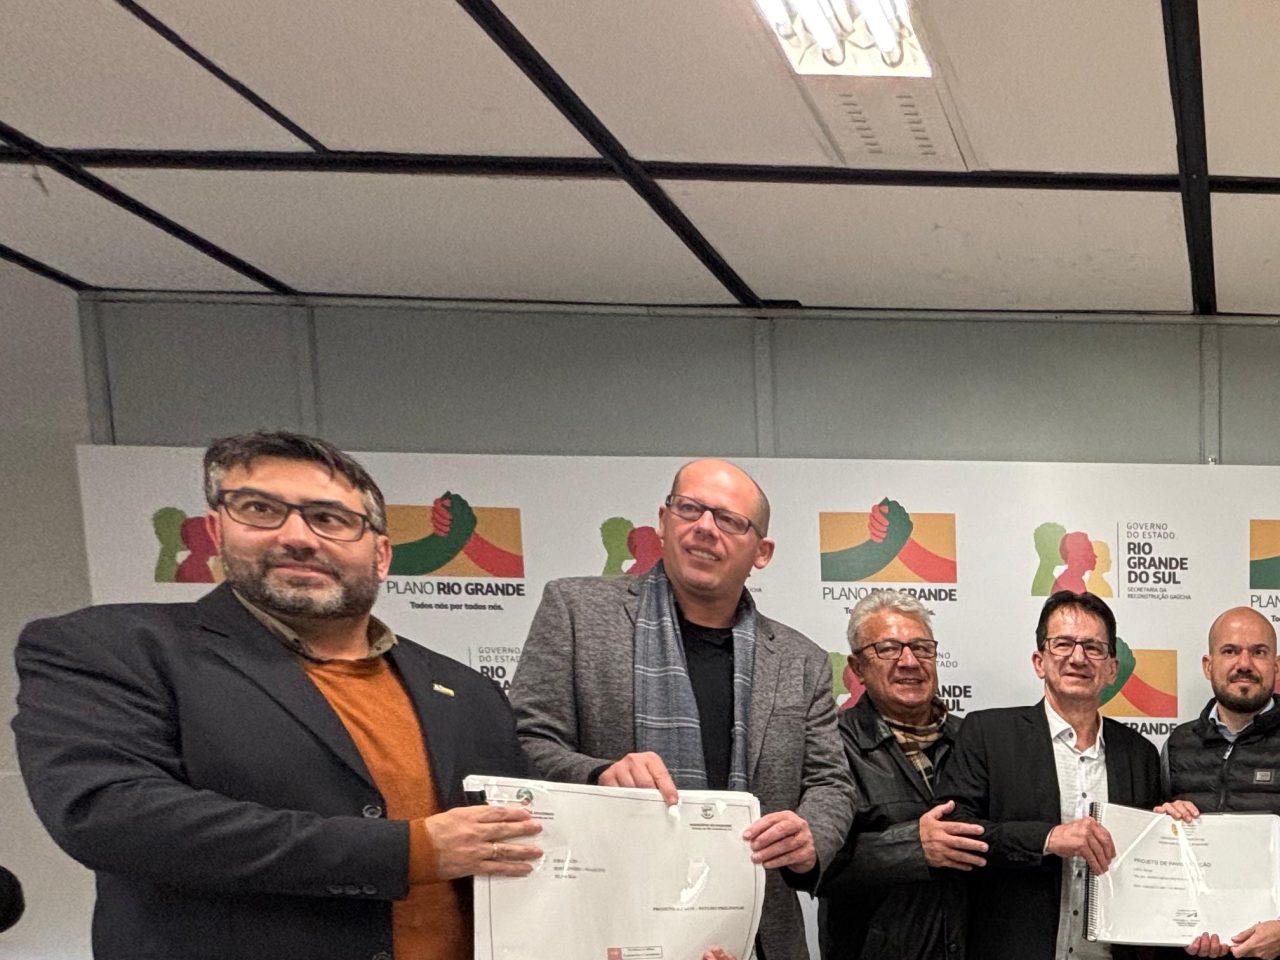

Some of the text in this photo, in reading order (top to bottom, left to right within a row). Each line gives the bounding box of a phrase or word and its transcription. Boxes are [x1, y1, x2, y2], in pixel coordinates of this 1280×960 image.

[1127, 522, 1168, 530] GOVERNO
[1127, 531, 1175, 539] DO ESTADO
[1127, 542, 1153, 555] RIO
[1127, 556, 1189, 570] GRANDE
[1128, 571, 1181, 585] DO SUL
[387, 580, 525, 596] PLANO RIO GRANDE
[822, 587, 869, 600] PLANO
[410, 601, 504, 611] Todos nós por todos nós.
[478, 646, 521, 654] GOVERNO
[479, 655, 492, 663] DO
[480, 665, 506, 679] RIO
